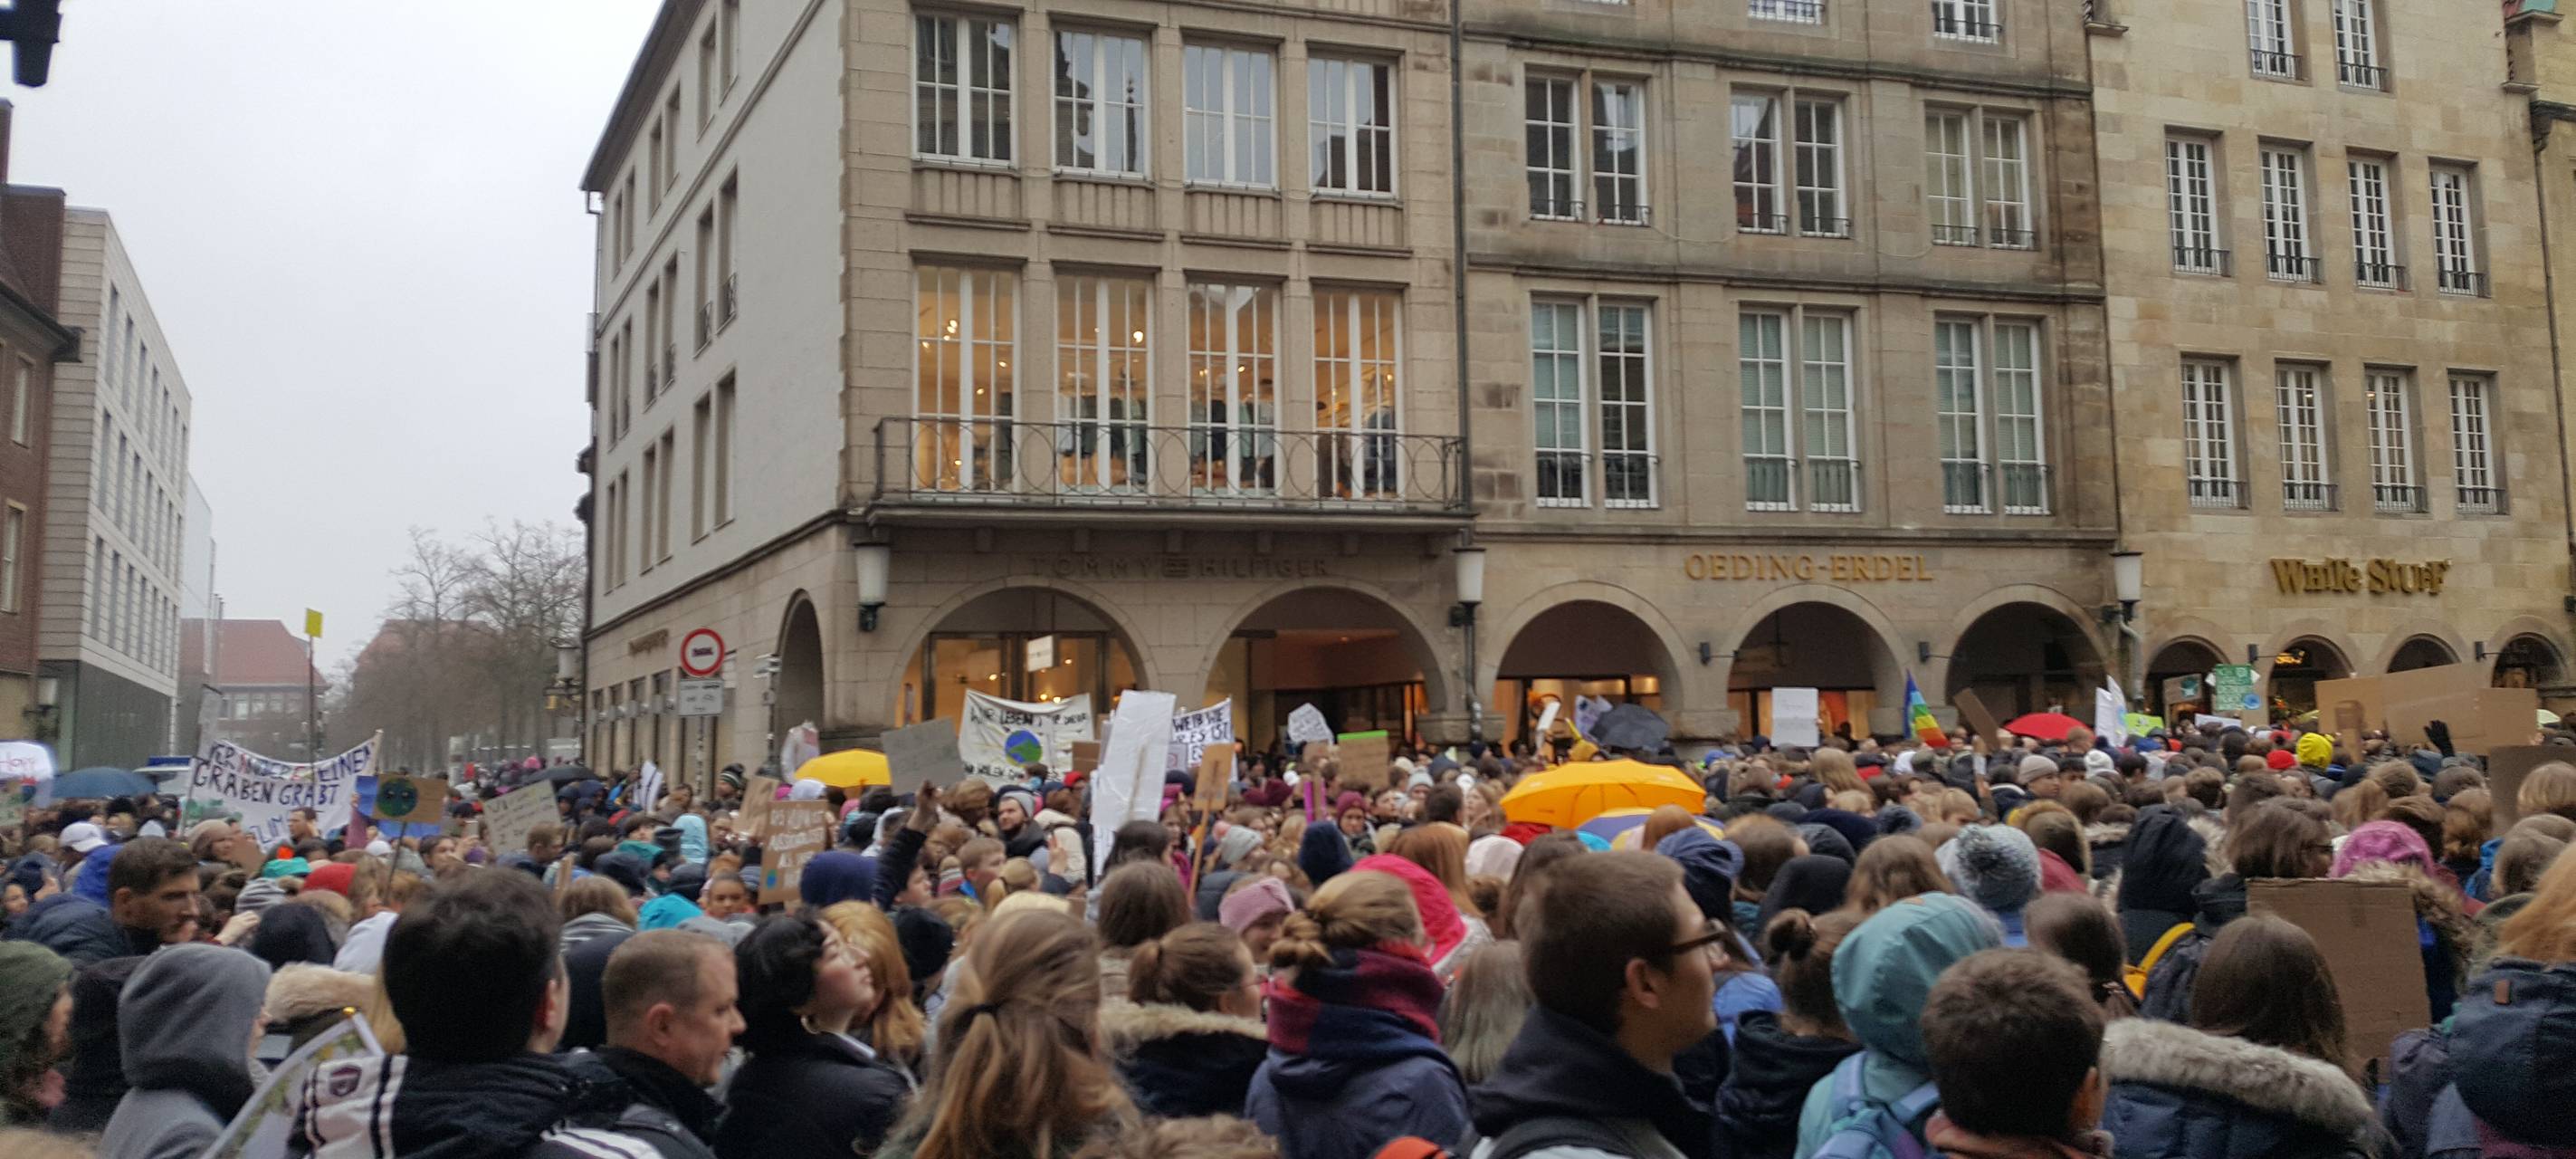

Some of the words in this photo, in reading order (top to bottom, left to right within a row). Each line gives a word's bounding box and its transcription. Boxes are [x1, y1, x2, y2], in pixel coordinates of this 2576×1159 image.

[1030, 557, 1152, 579] TOMMY
[1199, 558, 1329, 580] HILFIGER
[1684, 553, 1934, 582] OEDING-ERDEL
[193, 760, 275, 804] GRABEN
